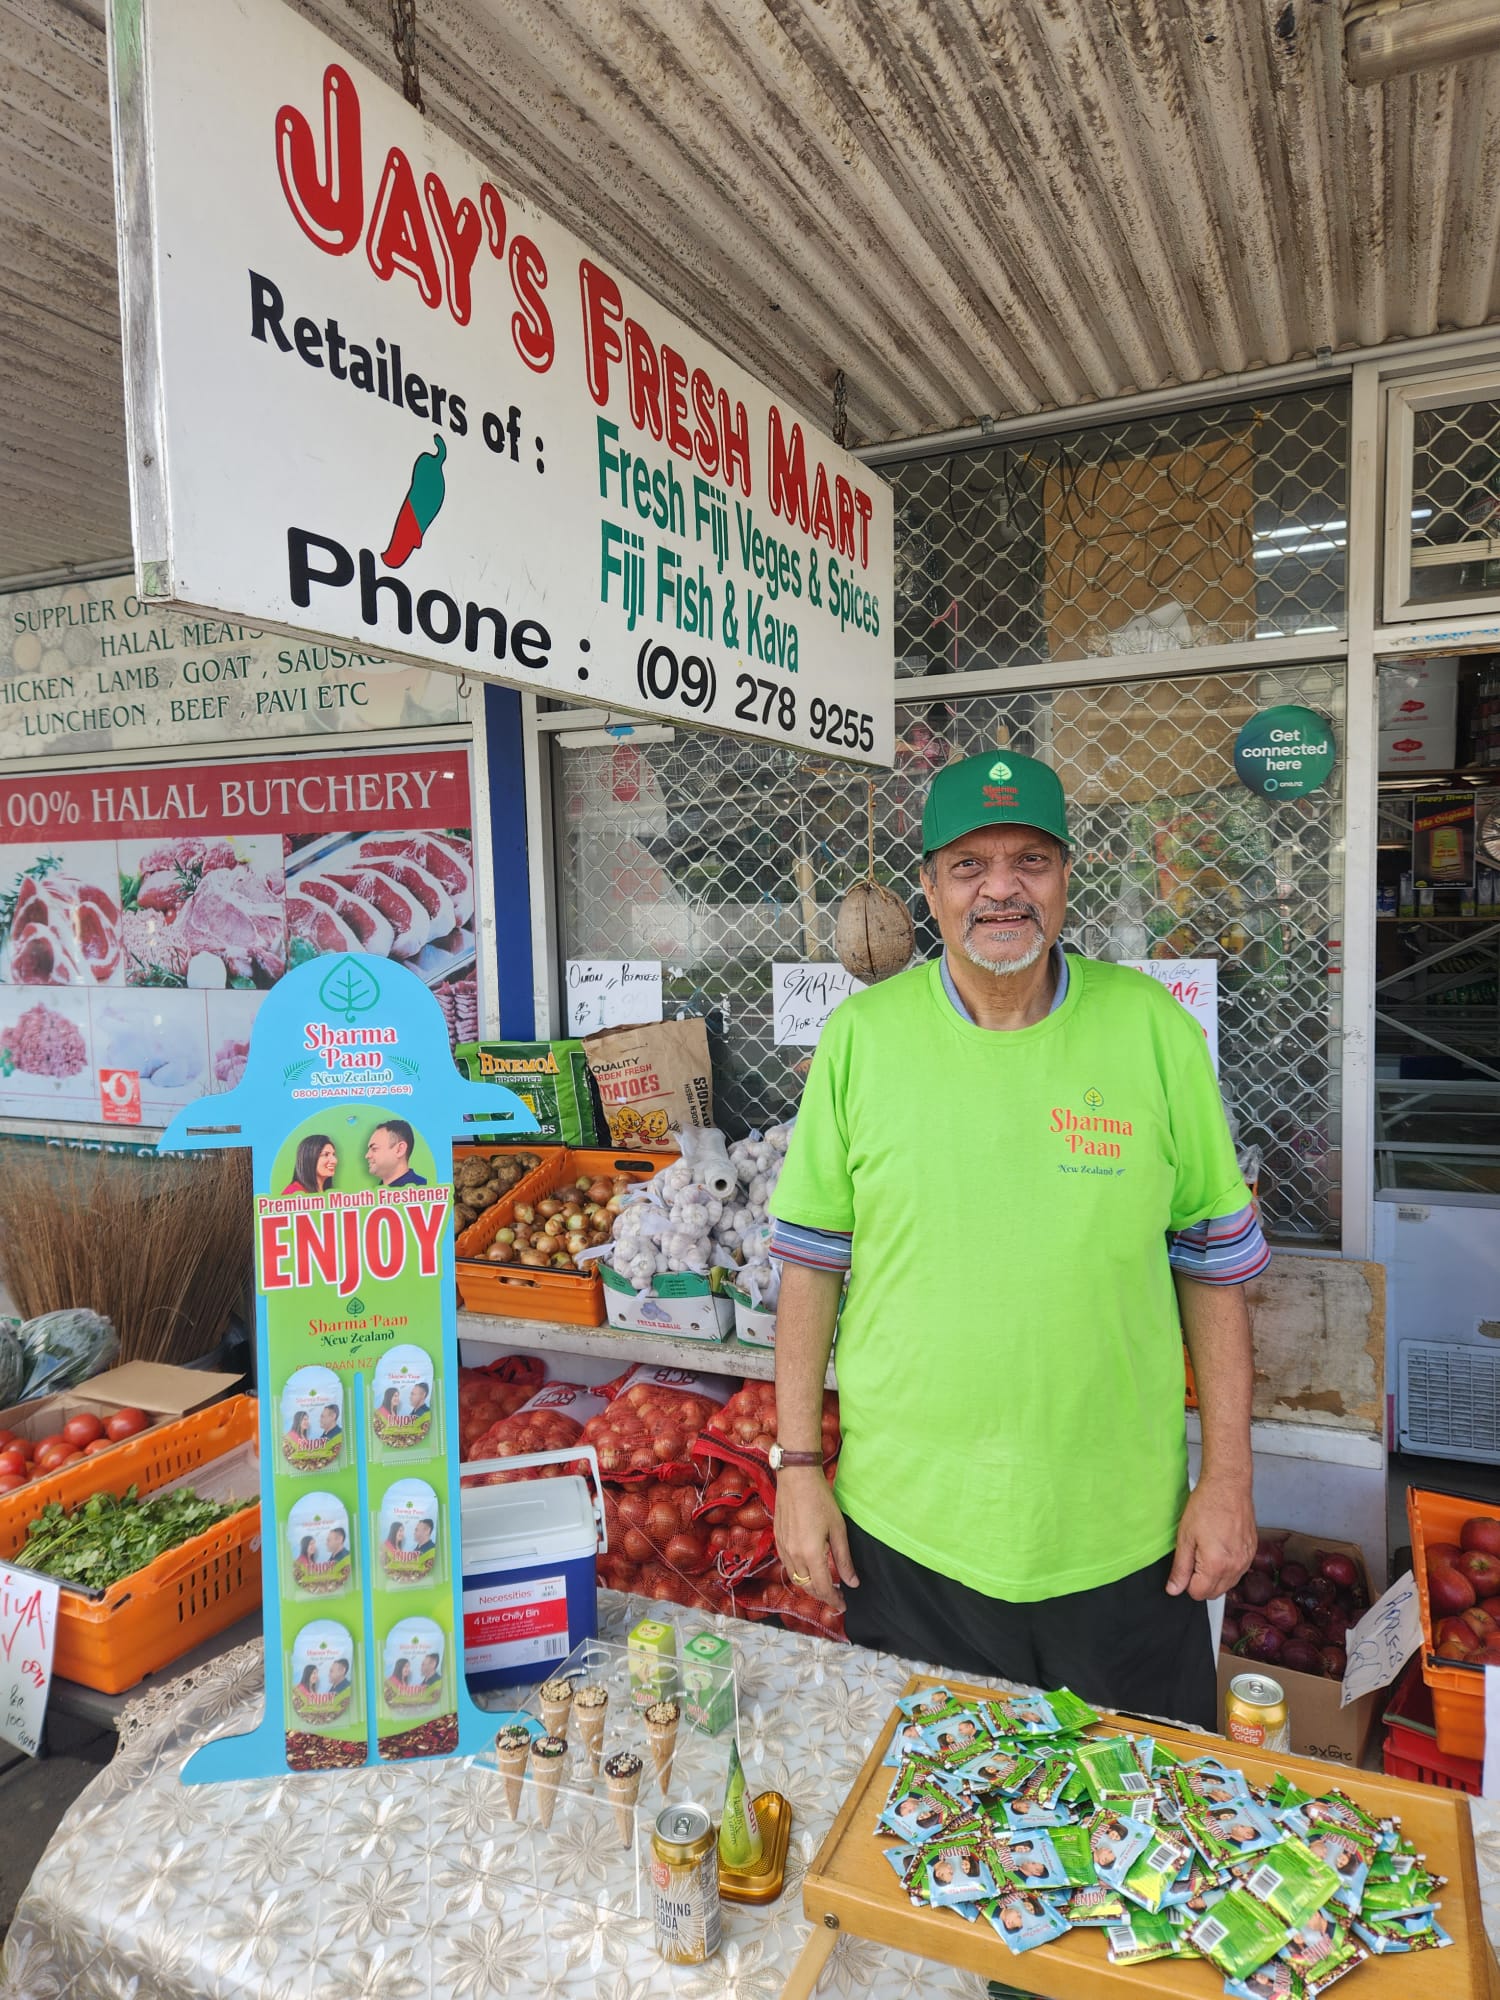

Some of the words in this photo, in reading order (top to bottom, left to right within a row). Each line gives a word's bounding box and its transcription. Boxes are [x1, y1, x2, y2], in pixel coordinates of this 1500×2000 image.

[275, 64, 555, 373] JAY'S
[579, 258, 752, 498] FRESH
[768, 405, 873, 570] MART
[248, 269, 468, 436] Retailers
[597, 415, 686, 537] Fresh
[693, 472, 729, 574] Fiji
[735, 501, 802, 601] Veges
[808, 547, 822, 608] &
[828, 557, 880, 637] Spices
[601, 519, 645, 632] Fiji
[656, 545, 714, 641] Fish
[722, 579, 739, 650] &
[747, 589, 799, 674] Kava
[14, 599, 115, 633] SUPPLIER
[100, 626, 175, 657] HALAL
[287, 526, 552, 669] Phone
[637, 638, 716, 714] (09)
[735, 673, 796, 731] 278
[809, 698, 874, 752] 9255
[255, 687, 308, 715] PAVI
[317, 682, 369, 709] ETC
[1269, 729, 1301, 742] Get
[1242, 740, 1328, 758] connected
[1266, 758, 1302, 771] here
[0, 790, 81, 827] 00%
[92, 782, 208, 823] HALAL
[220, 770, 441, 817] BUTCHERY
[303, 1023, 397, 1049] Sharma
[320, 1048, 382, 1069] Paan
[592, 1057, 640, 1073] QUALITY
[312, 1072, 341, 1085] New
[344, 1070, 392, 1084] Zealand
[625, 1063, 652, 1076] FRESH
[293, 1089, 318, 1098] 0800
[321, 1088, 348, 1097] PAAN
[351, 1086, 365, 1096] NZ
[1049, 1107, 1133, 1136] Sharma
[1065, 1134, 1121, 1159] Paan
[1058, 1164, 1078, 1173] New
[1080, 1165, 1113, 1175] Zealand
[258, 1195, 325, 1214] Premium
[329, 1191, 374, 1210] Mouth
[378, 1187, 449, 1205] Freshener
[260, 1203, 448, 1297] ENJOY
[308, 1318, 367, 1336] Sharma
[370, 1314, 409, 1328] Paan
[320, 1334, 349, 1347] New
[350, 1329, 395, 1344] Zealand
[479, 1590, 533, 1604] Necessities
[474, 1617, 480, 1625] 4
[481, 1615, 500, 1625] Litre
[502, 1610, 524, 1622] Chilly
[525, 1608, 540, 1618] Bin
[1230, 1722, 1262, 1737] golden
[1234, 1732, 1260, 1744] circle
[938, 1845, 970, 1858] ENJOY
[1075, 1889, 1107, 1907] ENJOY
